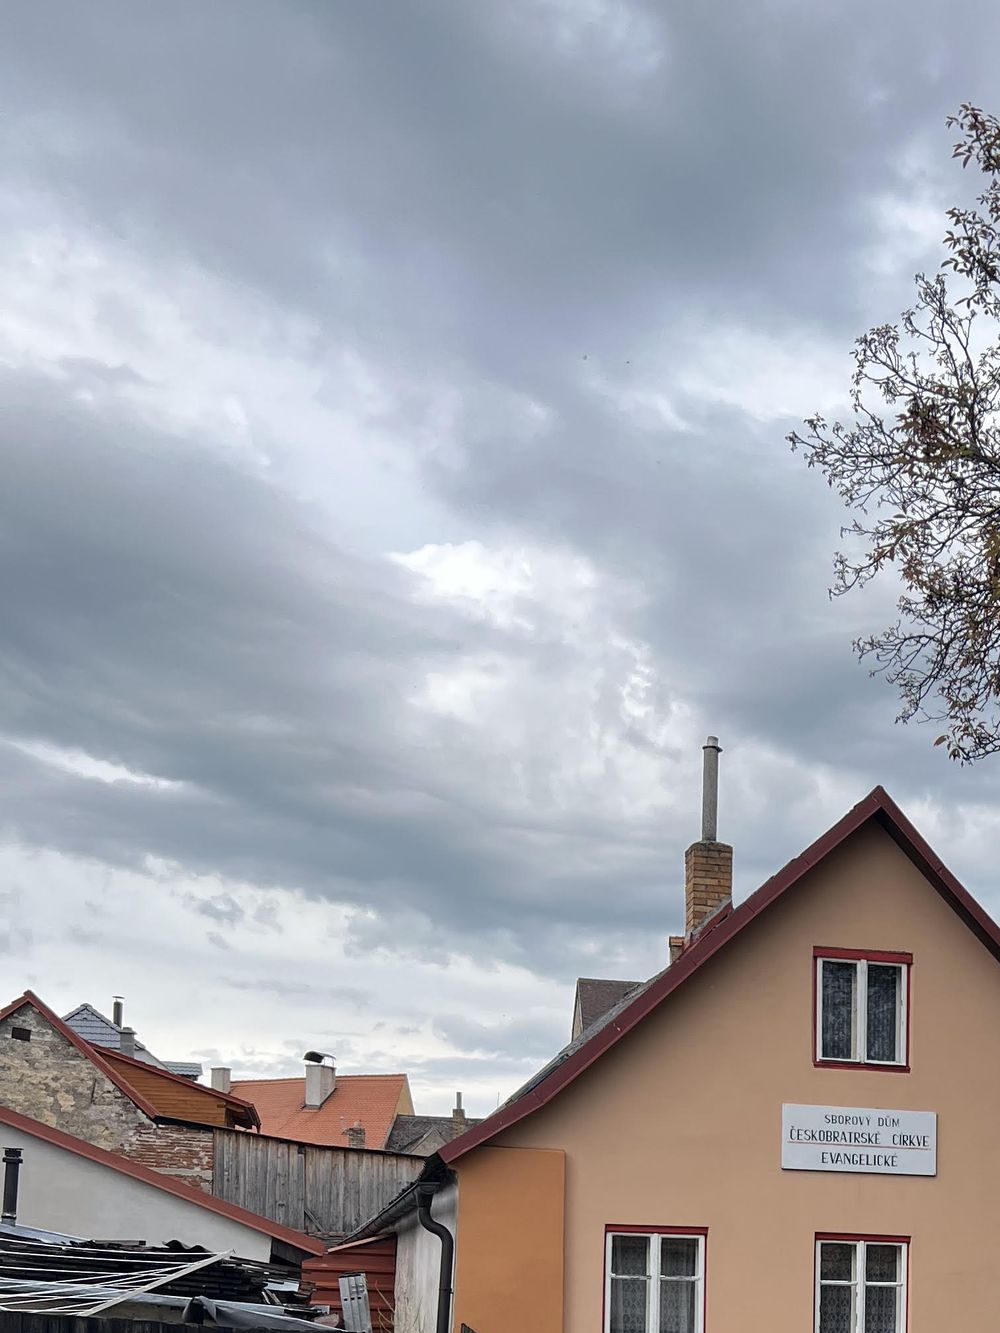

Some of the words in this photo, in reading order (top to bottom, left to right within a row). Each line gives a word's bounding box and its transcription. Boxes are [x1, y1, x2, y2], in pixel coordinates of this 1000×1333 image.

[824, 1114, 872, 1126] SBOROVÝ
[878, 1115, 900, 1128] DŮM
[789, 1125, 881, 1145] ČESKOBRATRSKÉ
[892, 1132, 930, 1148] CÍRKVE
[821, 1152, 898, 1167] EVANGELICKÉ
